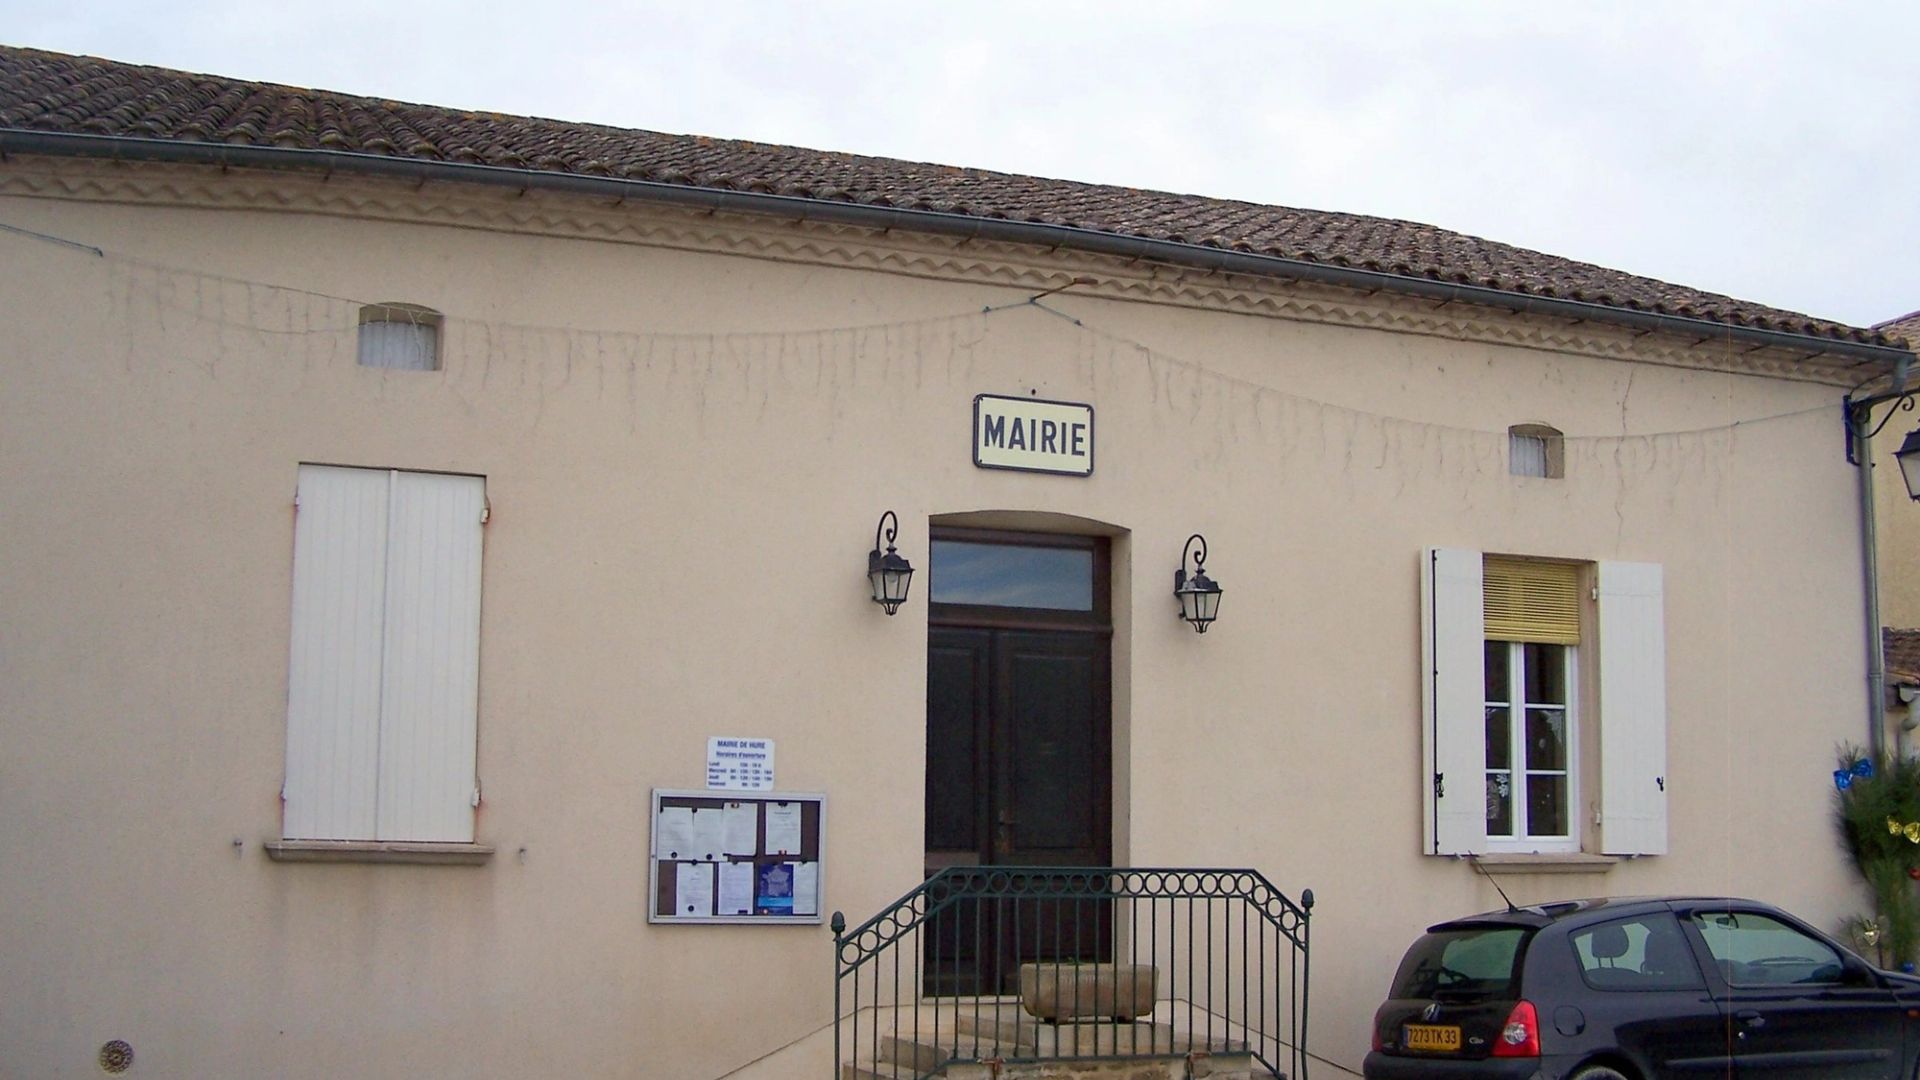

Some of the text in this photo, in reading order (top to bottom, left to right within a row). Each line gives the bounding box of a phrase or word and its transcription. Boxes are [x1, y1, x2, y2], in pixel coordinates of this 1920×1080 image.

[984, 414, 1086, 456] MAIRIE
[717, 740, 738, 748] MAIRIE
[1408, 1028, 1457, 1044] 7273 TK 33
